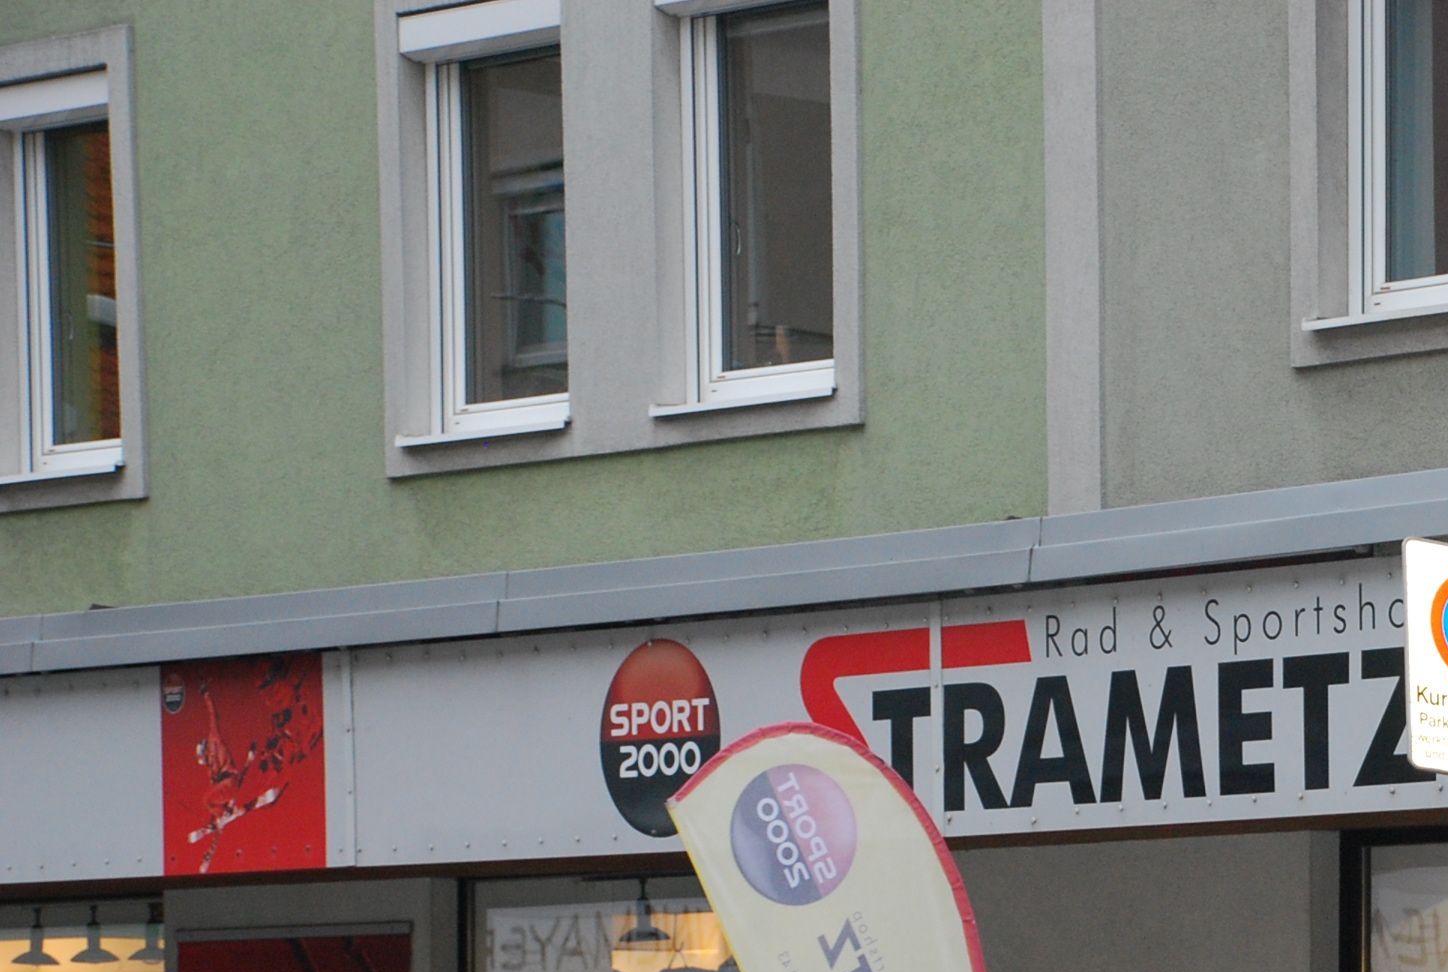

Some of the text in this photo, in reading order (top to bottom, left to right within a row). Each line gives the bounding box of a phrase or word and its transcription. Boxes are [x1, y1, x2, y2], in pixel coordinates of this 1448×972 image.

[1045, 583, 1405, 659] Rad & Sportsho
[610, 698, 710, 737] SPORT
[619, 741, 702, 778] 2000
